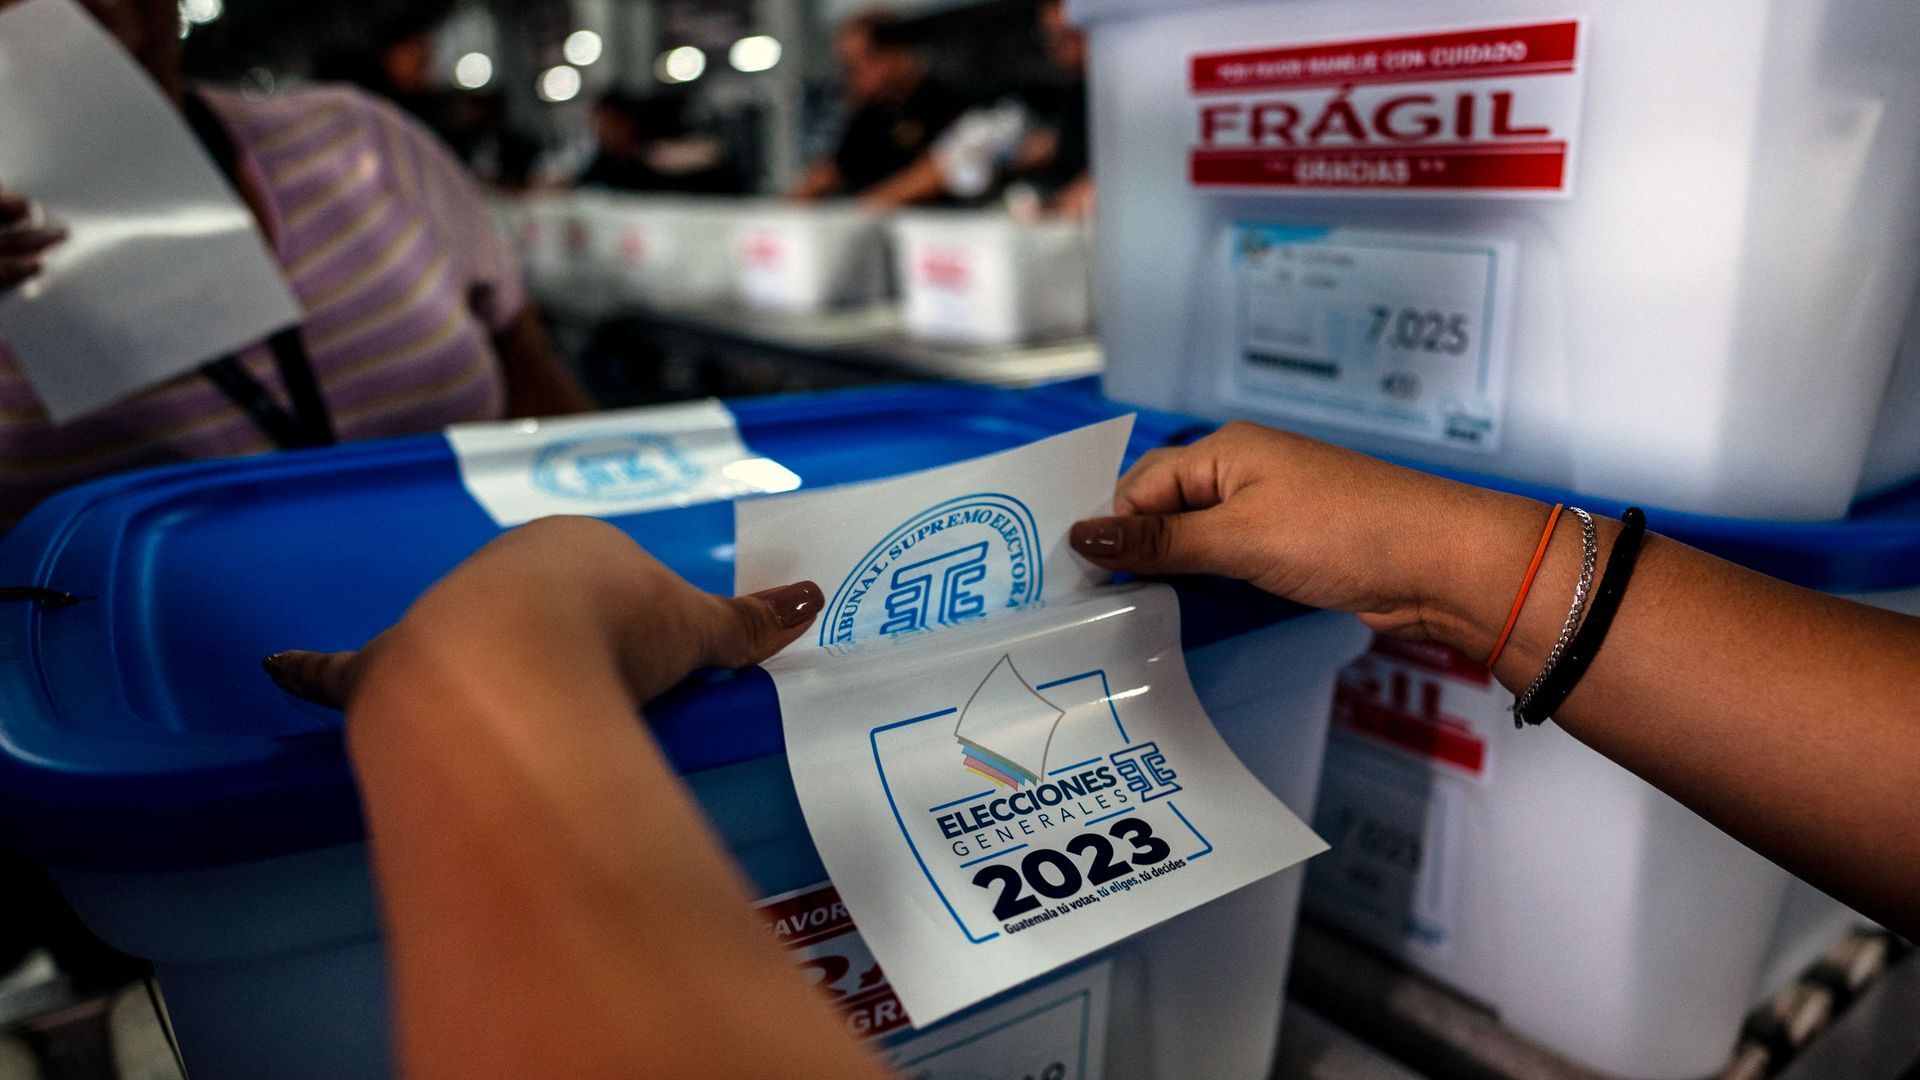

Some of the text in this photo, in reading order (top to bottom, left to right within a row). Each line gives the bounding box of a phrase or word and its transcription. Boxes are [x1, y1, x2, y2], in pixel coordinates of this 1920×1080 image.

[1383, 49, 1425, 69] CON
[1430, 39, 1528, 67] CUIDADO
[1201, 84, 1551, 144] FRÁGIL
[1294, 156, 1411, 186] GRACIAS
[837, 509, 1026, 642] IBUNAL SUPREMO ELECTORA
[936, 766, 1117, 840] ELECCIONES
[952, 789, 1128, 857] GENERALES
[972, 817, 1171, 922] 2023
[1004, 858, 1187, 934] Guatemala tú votas, tú eliges, tú decides
[772, 902, 848, 937] AVOR
